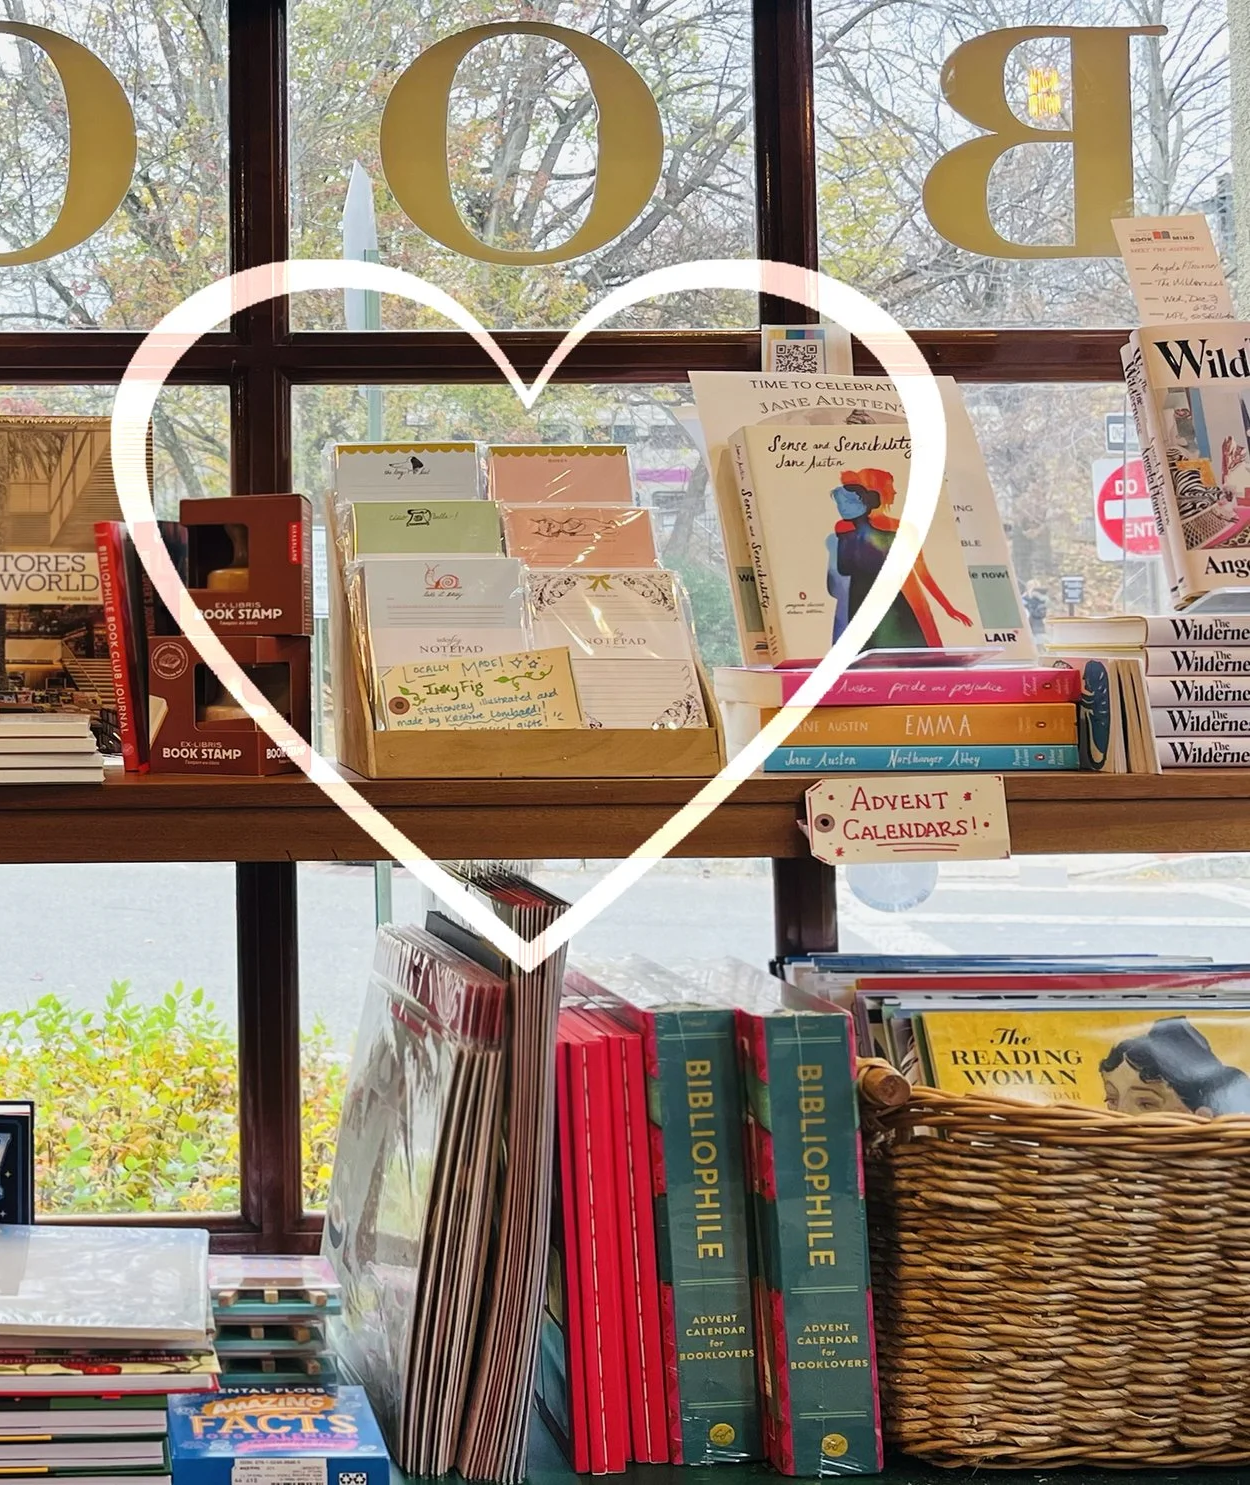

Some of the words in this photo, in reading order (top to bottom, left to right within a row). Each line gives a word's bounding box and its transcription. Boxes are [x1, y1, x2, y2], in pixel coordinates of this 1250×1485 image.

[750, 380, 789, 389] TIME
[792, 381, 812, 389] TO
[759, 397, 810, 414] JANE
[768, 435, 808, 452] Sense
[813, 442, 830, 450] and
[834, 436, 912, 459] Sensibility
[776, 454, 806, 468] Jane
[1114, 479, 1138, 496] DO
[741, 489, 753, 520] Sense
[0, 573, 100, 592] WORLD
[98, 545, 115, 613] BIBLIOPHILE
[238, 608, 282, 620] STAMP
[1213, 619, 1230, 628] The
[106, 616, 120, 649] BOOK
[984, 632, 1017, 642] LAIR
[419, 645, 484, 654] NOTEPAD
[584, 637, 647, 646] NOTEPAD
[1214, 651, 1231, 660] The
[111, 651, 123, 679] CLUB
[402, 663, 451, 684] LOCALLY
[461, 656, 505, 678] MADE!
[888, 682, 927, 699] pride
[948, 680, 1006, 701] prejudice
[1213, 680, 1230, 689] The
[479, 692, 533, 706] illustrated
[537, 687, 559, 700] and
[115, 680, 129, 733] JOURNAL
[1211, 710, 1228, 719] The
[397, 715, 423, 727] made
[428, 713, 442, 727] by
[828, 721, 869, 732] AUSTEN
[905, 714, 972, 738] EMMA
[162, 748, 198, 759] BOOK
[201, 749, 242, 761] STAMP
[1213, 742, 1230, 751] The
[785, 750, 812, 766] Jane
[818, 752, 857, 767] Austen
[886, 749, 943, 768] Northanger
[949, 749, 981, 767] Abbey
[850, 786, 949, 811] ADVENT
[843, 815, 978, 841] CALENDARS!
[989, 1027, 1032, 1045] The
[951, 1049, 1083, 1065] READING
[962, 1069, 1079, 1086] WOMAN
[686, 1060, 725, 1259] BIBLIOPHILE
[797, 1065, 836, 1267] BIBLIOPHILE
[692, 1315, 738, 1325] ADVENT
[804, 1323, 850, 1333] ADVENT
[686, 1326, 746, 1337] CALENDAR
[709, 1339, 724, 1348] for
[797, 1335, 859, 1345] CALENDAR
[679, 1349, 755, 1361] BOOKLOVERS
[821, 1348, 836, 1357] for
[790, 1359, 869, 1370] BOOKLOVERS
[212, 1396, 325, 1415] AMAZING
[190, 1413, 359, 1437] FACTS
[251, 1432, 360, 1440] CALENDAR
